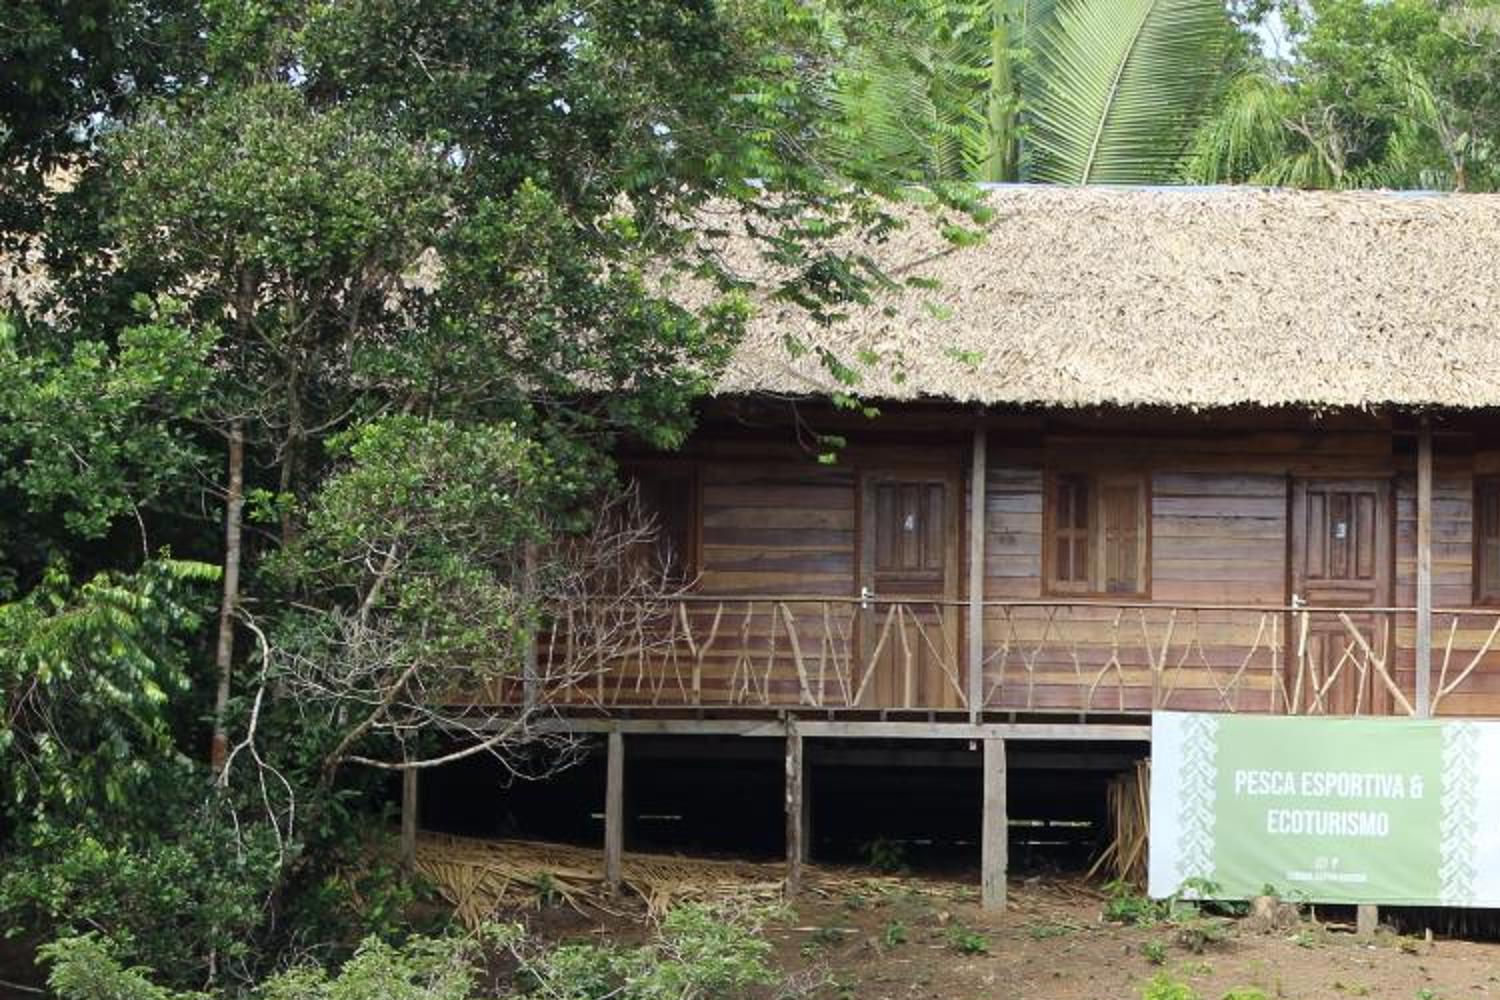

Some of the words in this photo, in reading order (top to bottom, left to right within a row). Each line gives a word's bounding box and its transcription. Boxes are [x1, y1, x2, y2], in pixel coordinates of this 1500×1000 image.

[1235, 770, 1296, 795] PESCA
[1301, 772, 1404, 798] ESPORTIVA
[1410, 774, 1424, 799] &
[1267, 809, 1389, 836] ECOTURISMO
